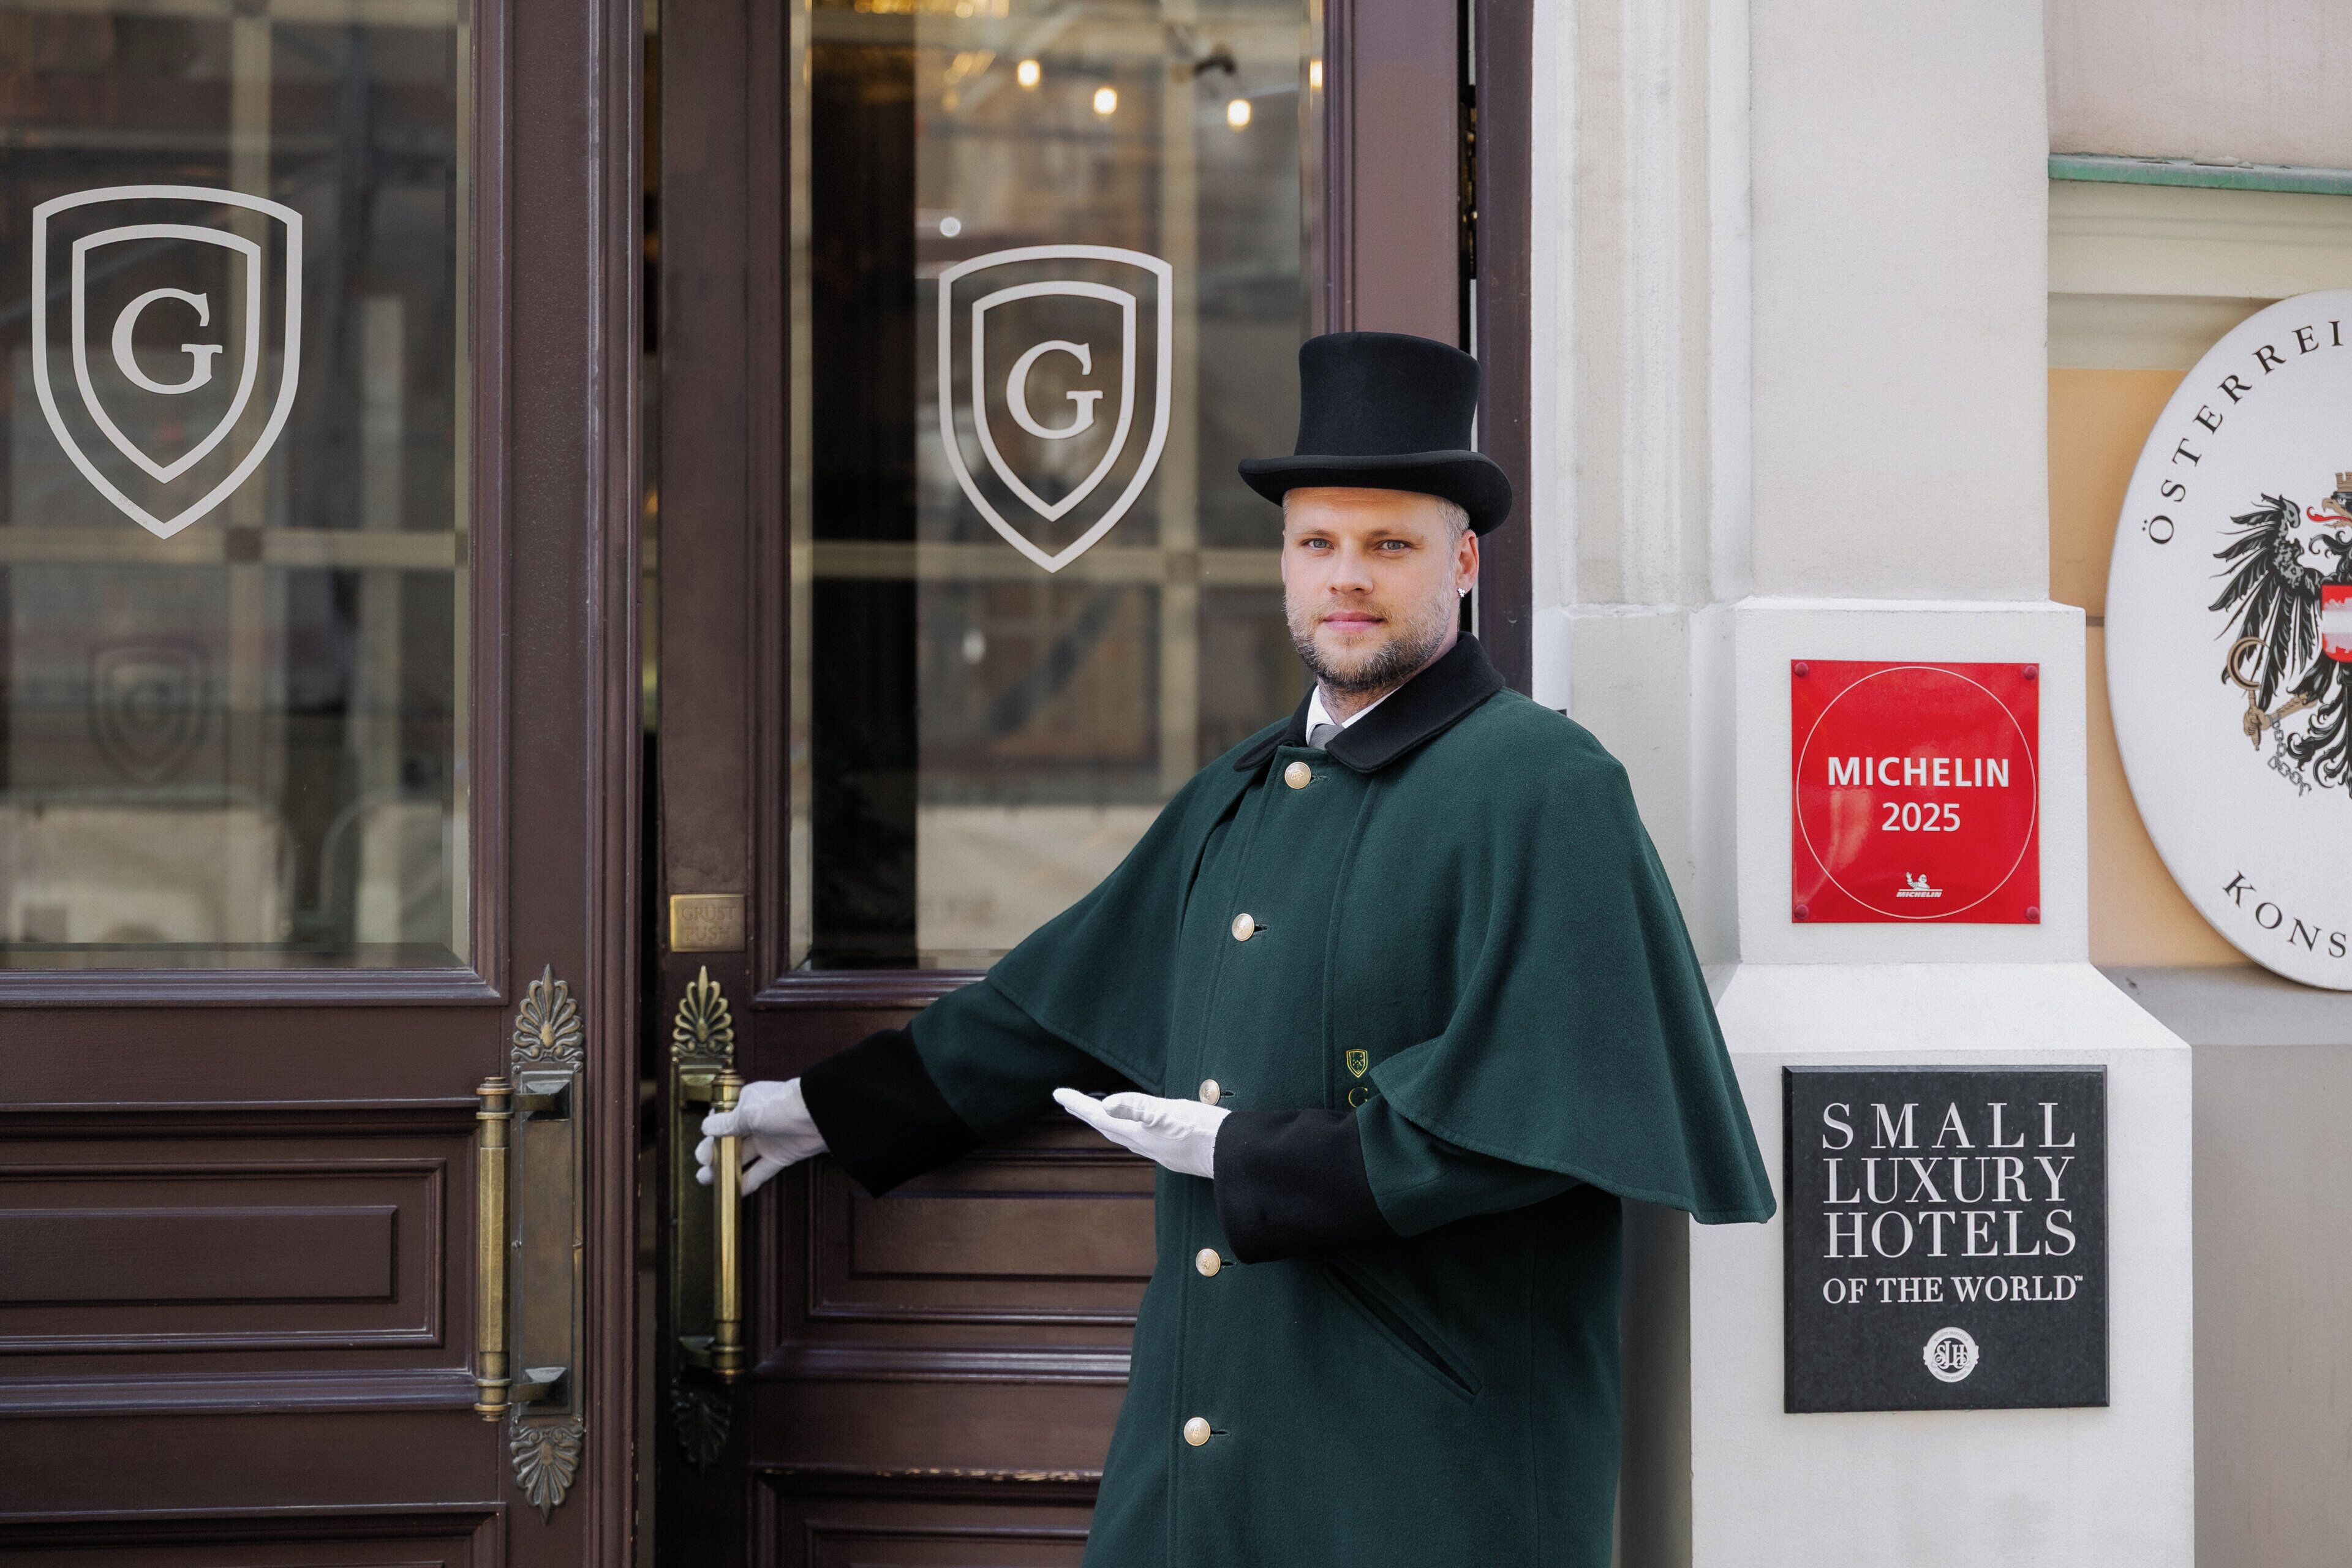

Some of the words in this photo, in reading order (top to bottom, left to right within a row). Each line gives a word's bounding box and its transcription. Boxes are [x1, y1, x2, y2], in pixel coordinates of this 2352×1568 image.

[111, 288, 223, 394] G
[1006, 340, 1103, 439] G
[2142, 320, 2344, 545] ÖSTERREI
[1828, 756, 2010, 787] MICHELIN
[1882, 802, 1961, 832] 2025
[682, 926, 731, 941] PUSH
[2223, 870, 2347, 958] KONS
[1822, 1102, 2076, 1150] SMALL
[1823, 1156, 2075, 1204] LUXURY
[1823, 1208, 2076, 1258] HOTELS
[1823, 1278, 1868, 1304] OF
[1875, 1276, 1943, 1303] THE
